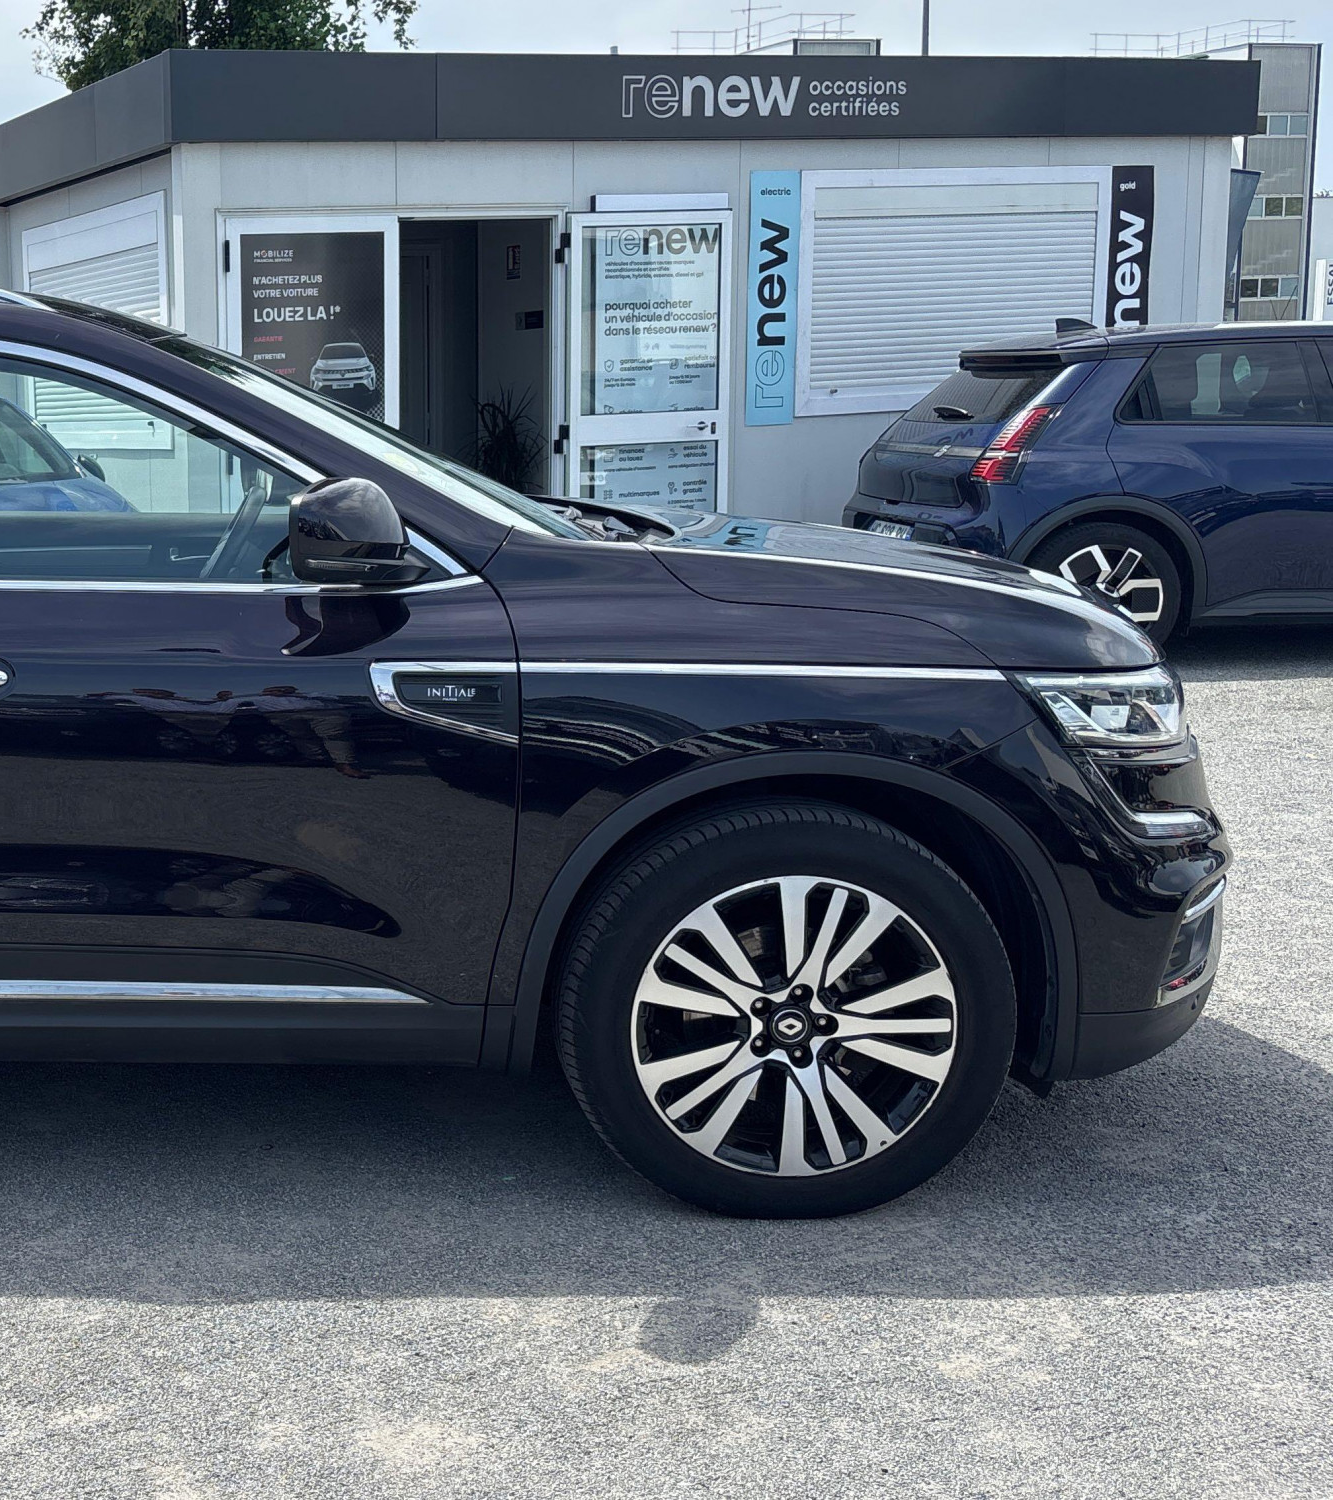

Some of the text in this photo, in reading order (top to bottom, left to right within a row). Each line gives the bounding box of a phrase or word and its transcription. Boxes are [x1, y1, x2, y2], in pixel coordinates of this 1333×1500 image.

[809, 76, 907, 96] occasions
[622, 74, 801, 119] renew
[808, 96, 900, 117] certifiées
[760, 187, 792, 196] electric
[1120, 181, 1136, 192] gold
[605, 227, 718, 256] renew
[253, 250, 294, 258] MOBILIZE
[1114, 210, 1145, 327] new
[253, 274, 323, 285] N'ACHETEZ PLUS
[253, 288, 319, 298] VOTRE VOITURE
[604, 299, 692, 313] pourquoi acheter
[254, 307, 304, 323] LOUEZ
[307, 306, 327, 320] LA
[604, 315, 618, 324] un
[619, 312, 662, 323] véhicule
[755, 218, 790, 408] renew
[604, 326, 631, 336] dans
[632, 325, 641, 336] le
[643, 324, 677, 335] réseau
[679, 325, 710, 333] renew
[618, 490, 660, 498] multimarques
[682, 487, 703, 495] gratuit
[427, 685, 476, 697] INITIALE
